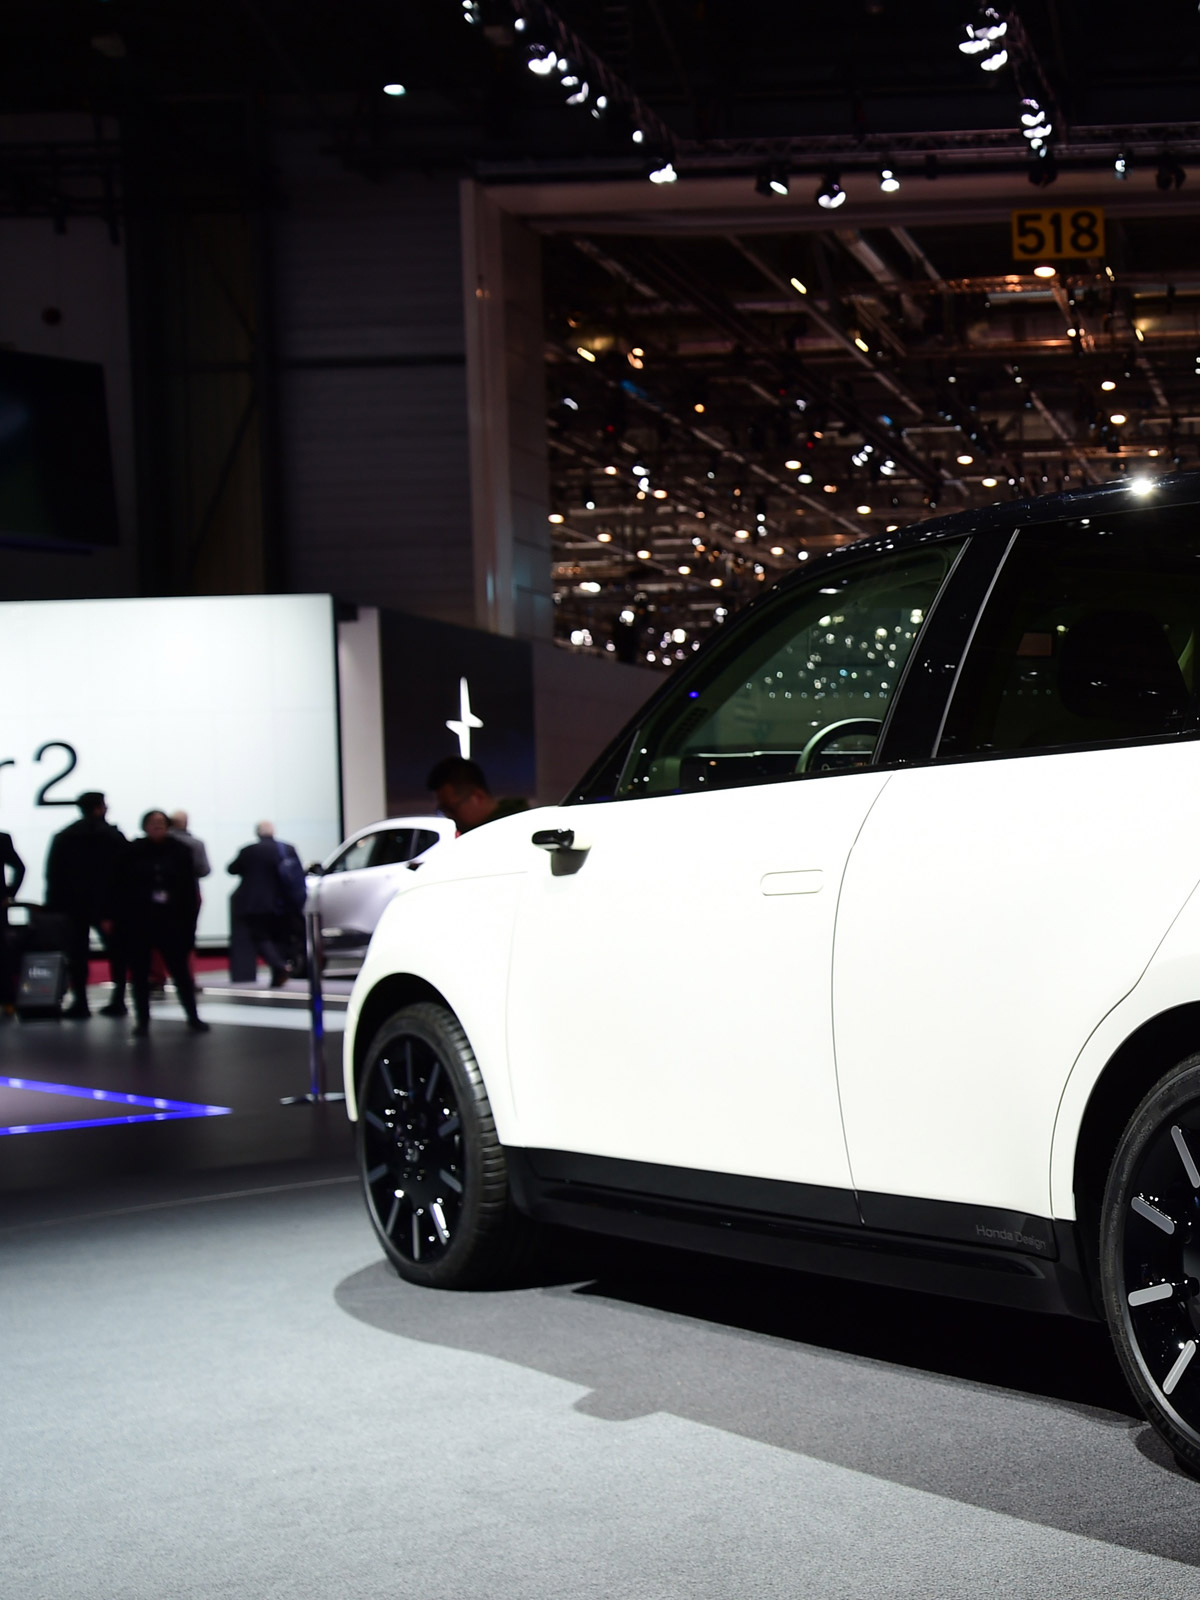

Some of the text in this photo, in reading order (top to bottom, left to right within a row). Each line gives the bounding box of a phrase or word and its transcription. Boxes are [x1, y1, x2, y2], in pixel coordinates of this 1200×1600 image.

[1017, 210, 1099, 255] 518
[36, 742, 78, 806] 2
[976, 1224, 1047, 1250] Honda Design
